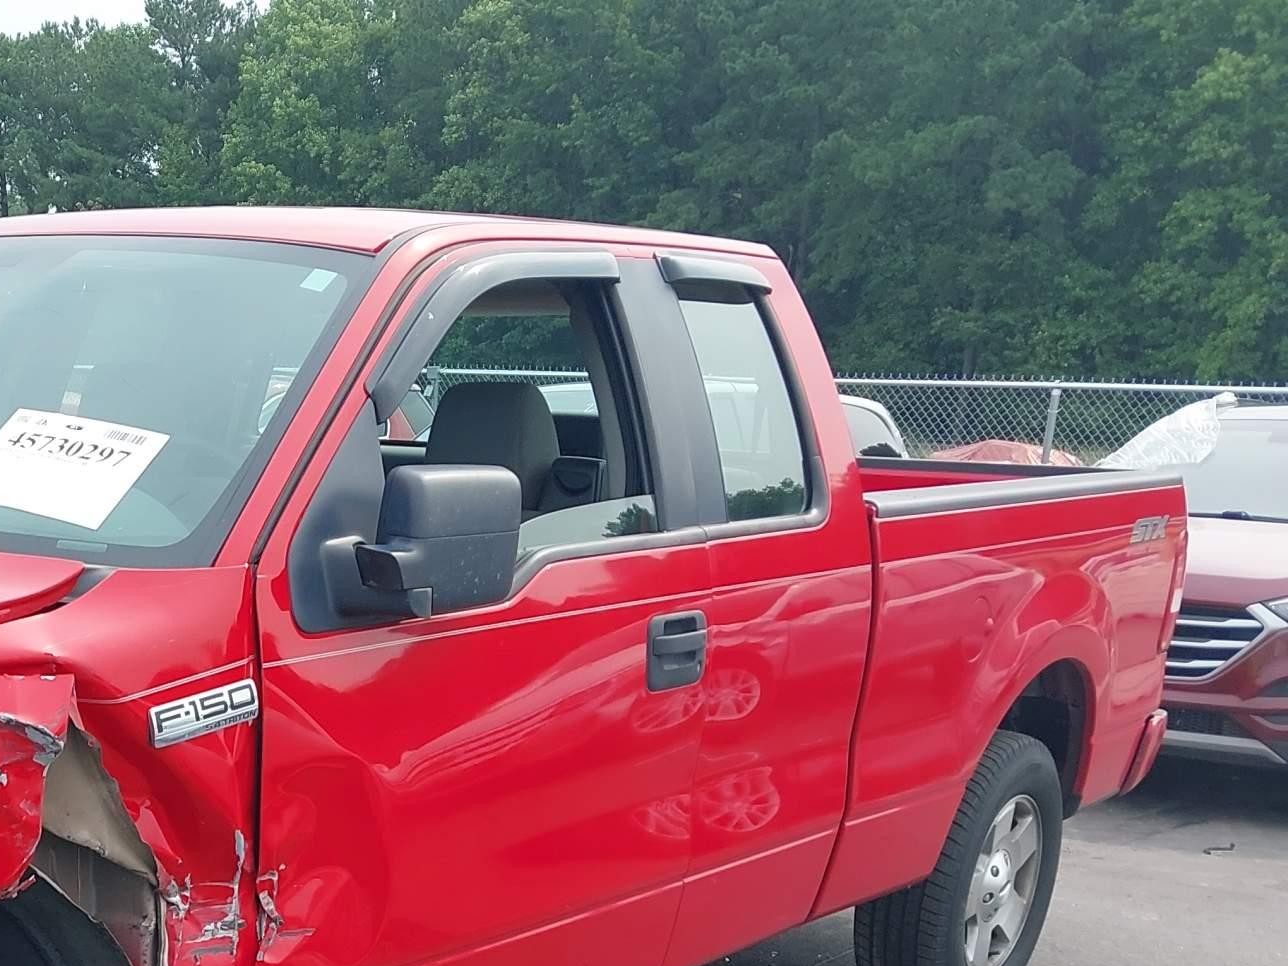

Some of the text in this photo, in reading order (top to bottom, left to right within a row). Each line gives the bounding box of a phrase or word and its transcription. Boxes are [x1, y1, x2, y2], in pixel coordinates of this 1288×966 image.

[8, 432, 132, 467] 45730297
[1130, 515, 1170, 543] STX
[154, 684, 256, 733] F-150
